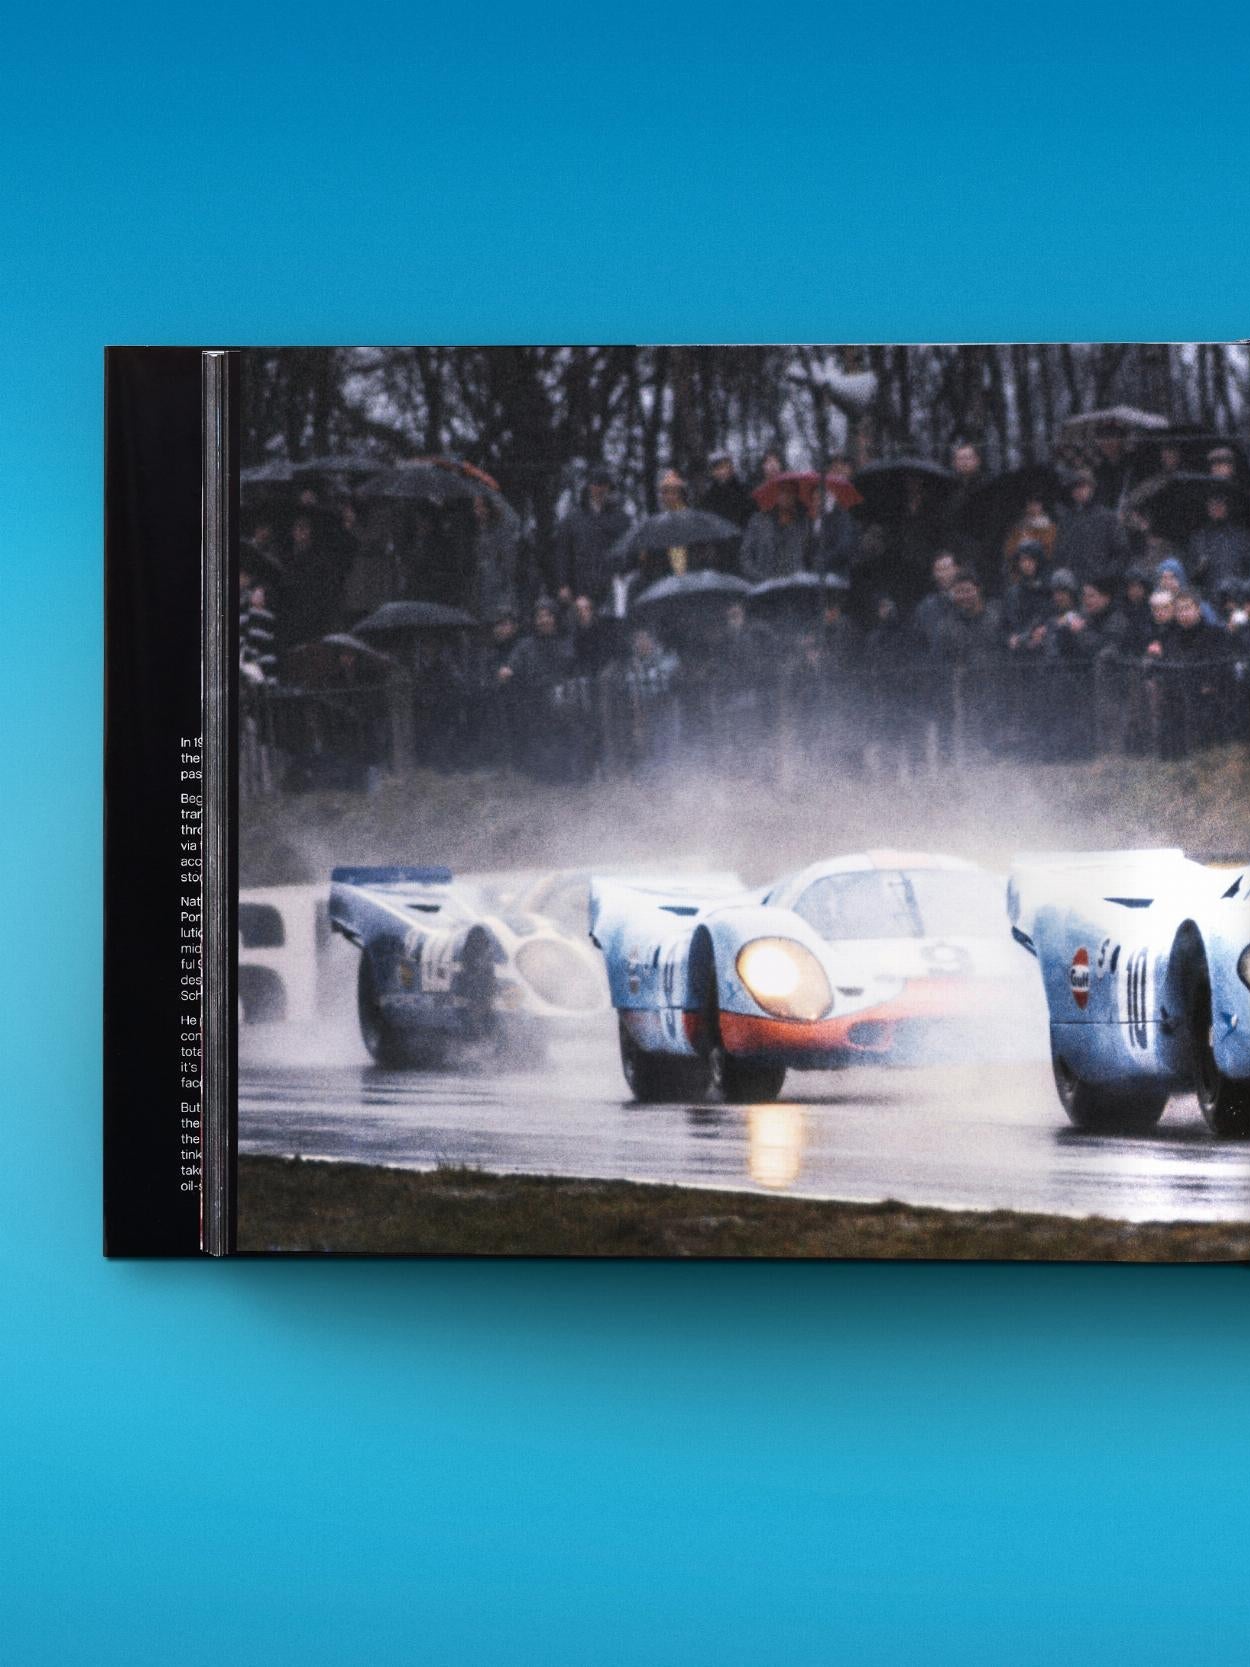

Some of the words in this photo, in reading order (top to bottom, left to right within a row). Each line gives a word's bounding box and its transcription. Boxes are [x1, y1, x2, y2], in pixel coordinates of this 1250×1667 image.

[180, 737, 191, 748] In
[180, 752, 200, 764] the
[180, 840, 197, 851] via
[180, 896, 201, 907] Nat
[180, 911, 201, 922] Por
[180, 958, 195, 970] ful
[180, 1015, 197, 1026] He
[180, 1102, 200, 1113] But
[180, 1133, 200, 1144] the
